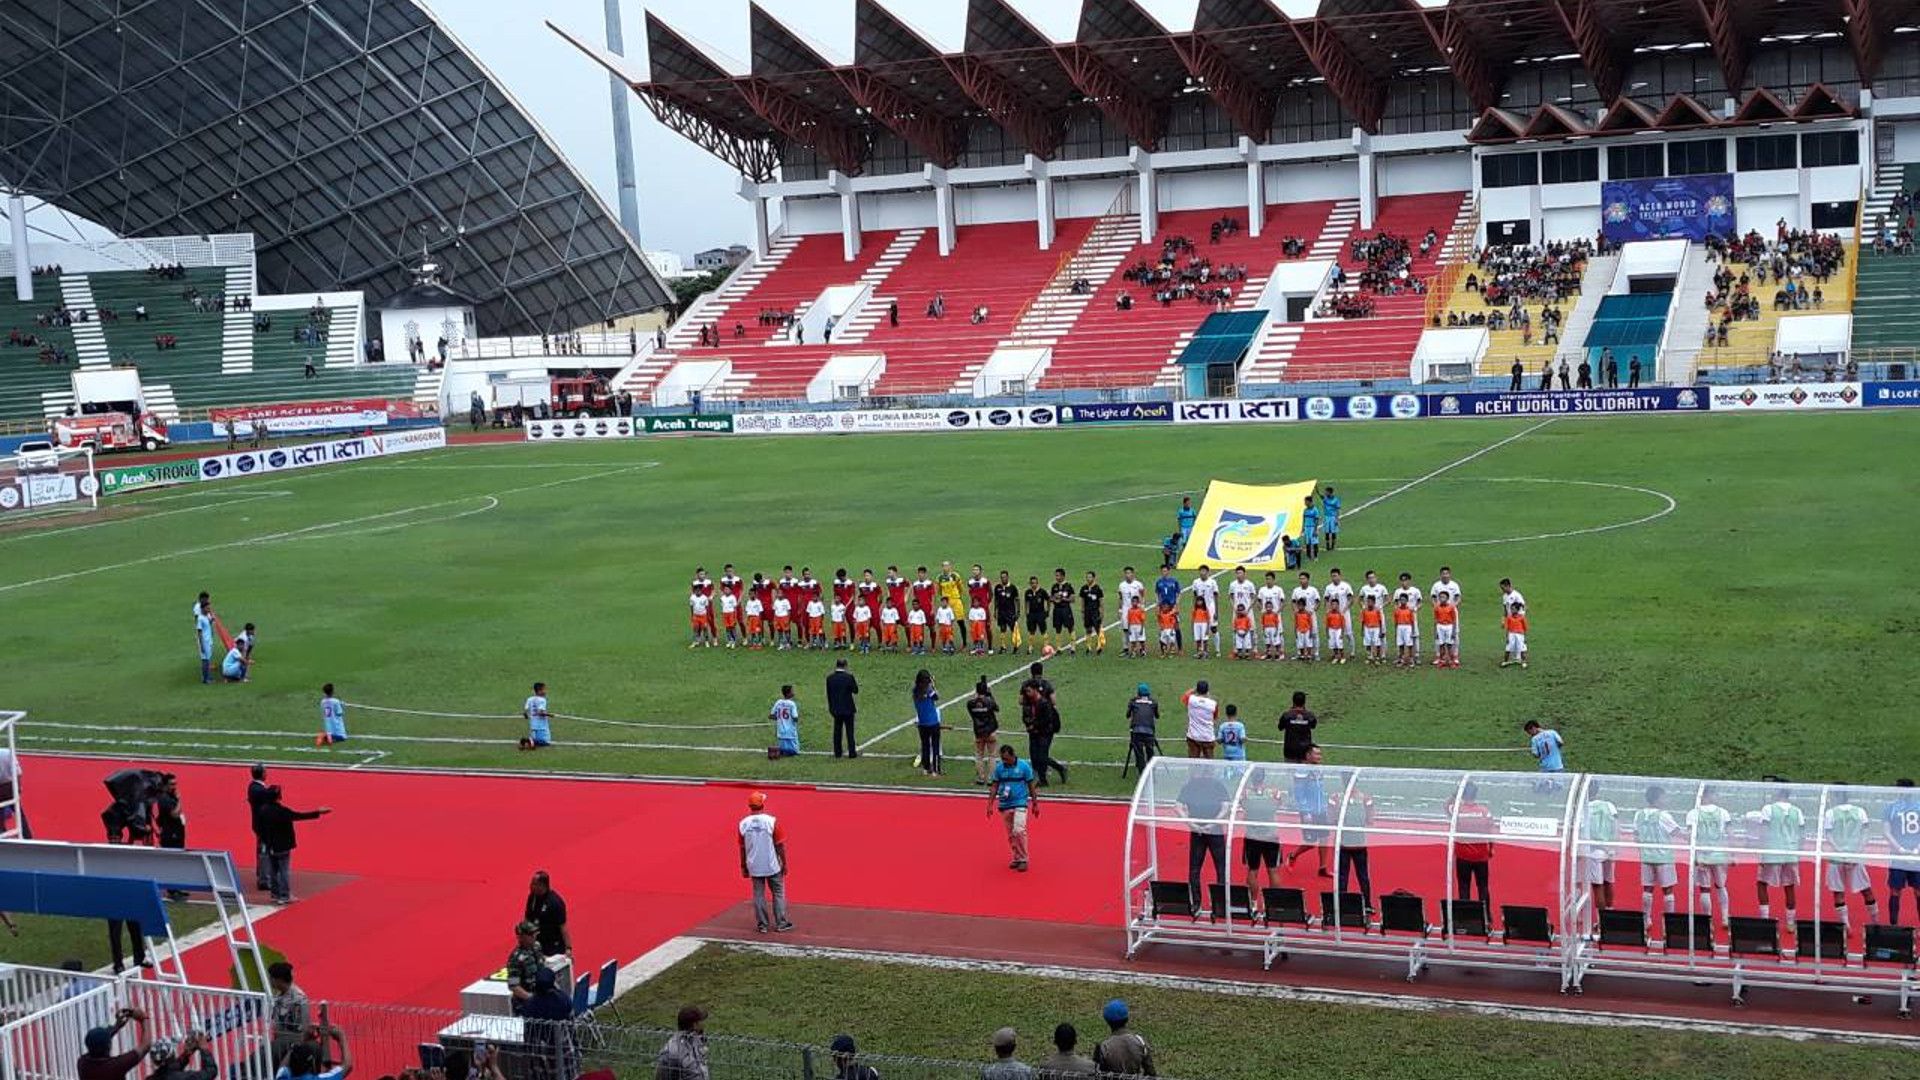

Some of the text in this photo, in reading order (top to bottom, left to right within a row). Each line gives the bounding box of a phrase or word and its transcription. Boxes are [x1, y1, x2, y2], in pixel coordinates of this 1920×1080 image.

[1639, 200, 1696, 211] ACEH WORLD
[1079, 404, 1167, 420] The Light of Aceh
[1180, 402, 1230, 420] RCTI
[1240, 400, 1290, 419] RCTI
[1475, 396, 1660, 414] ACEH WORLD SOLIDARITY
[653, 418, 686, 430] Aceh
[293, 444, 327, 465] RCTI
[333, 440, 365, 459] RCTI
[147, 463, 198, 483] STRONG
[1897, 811, 1920, 835] 18
